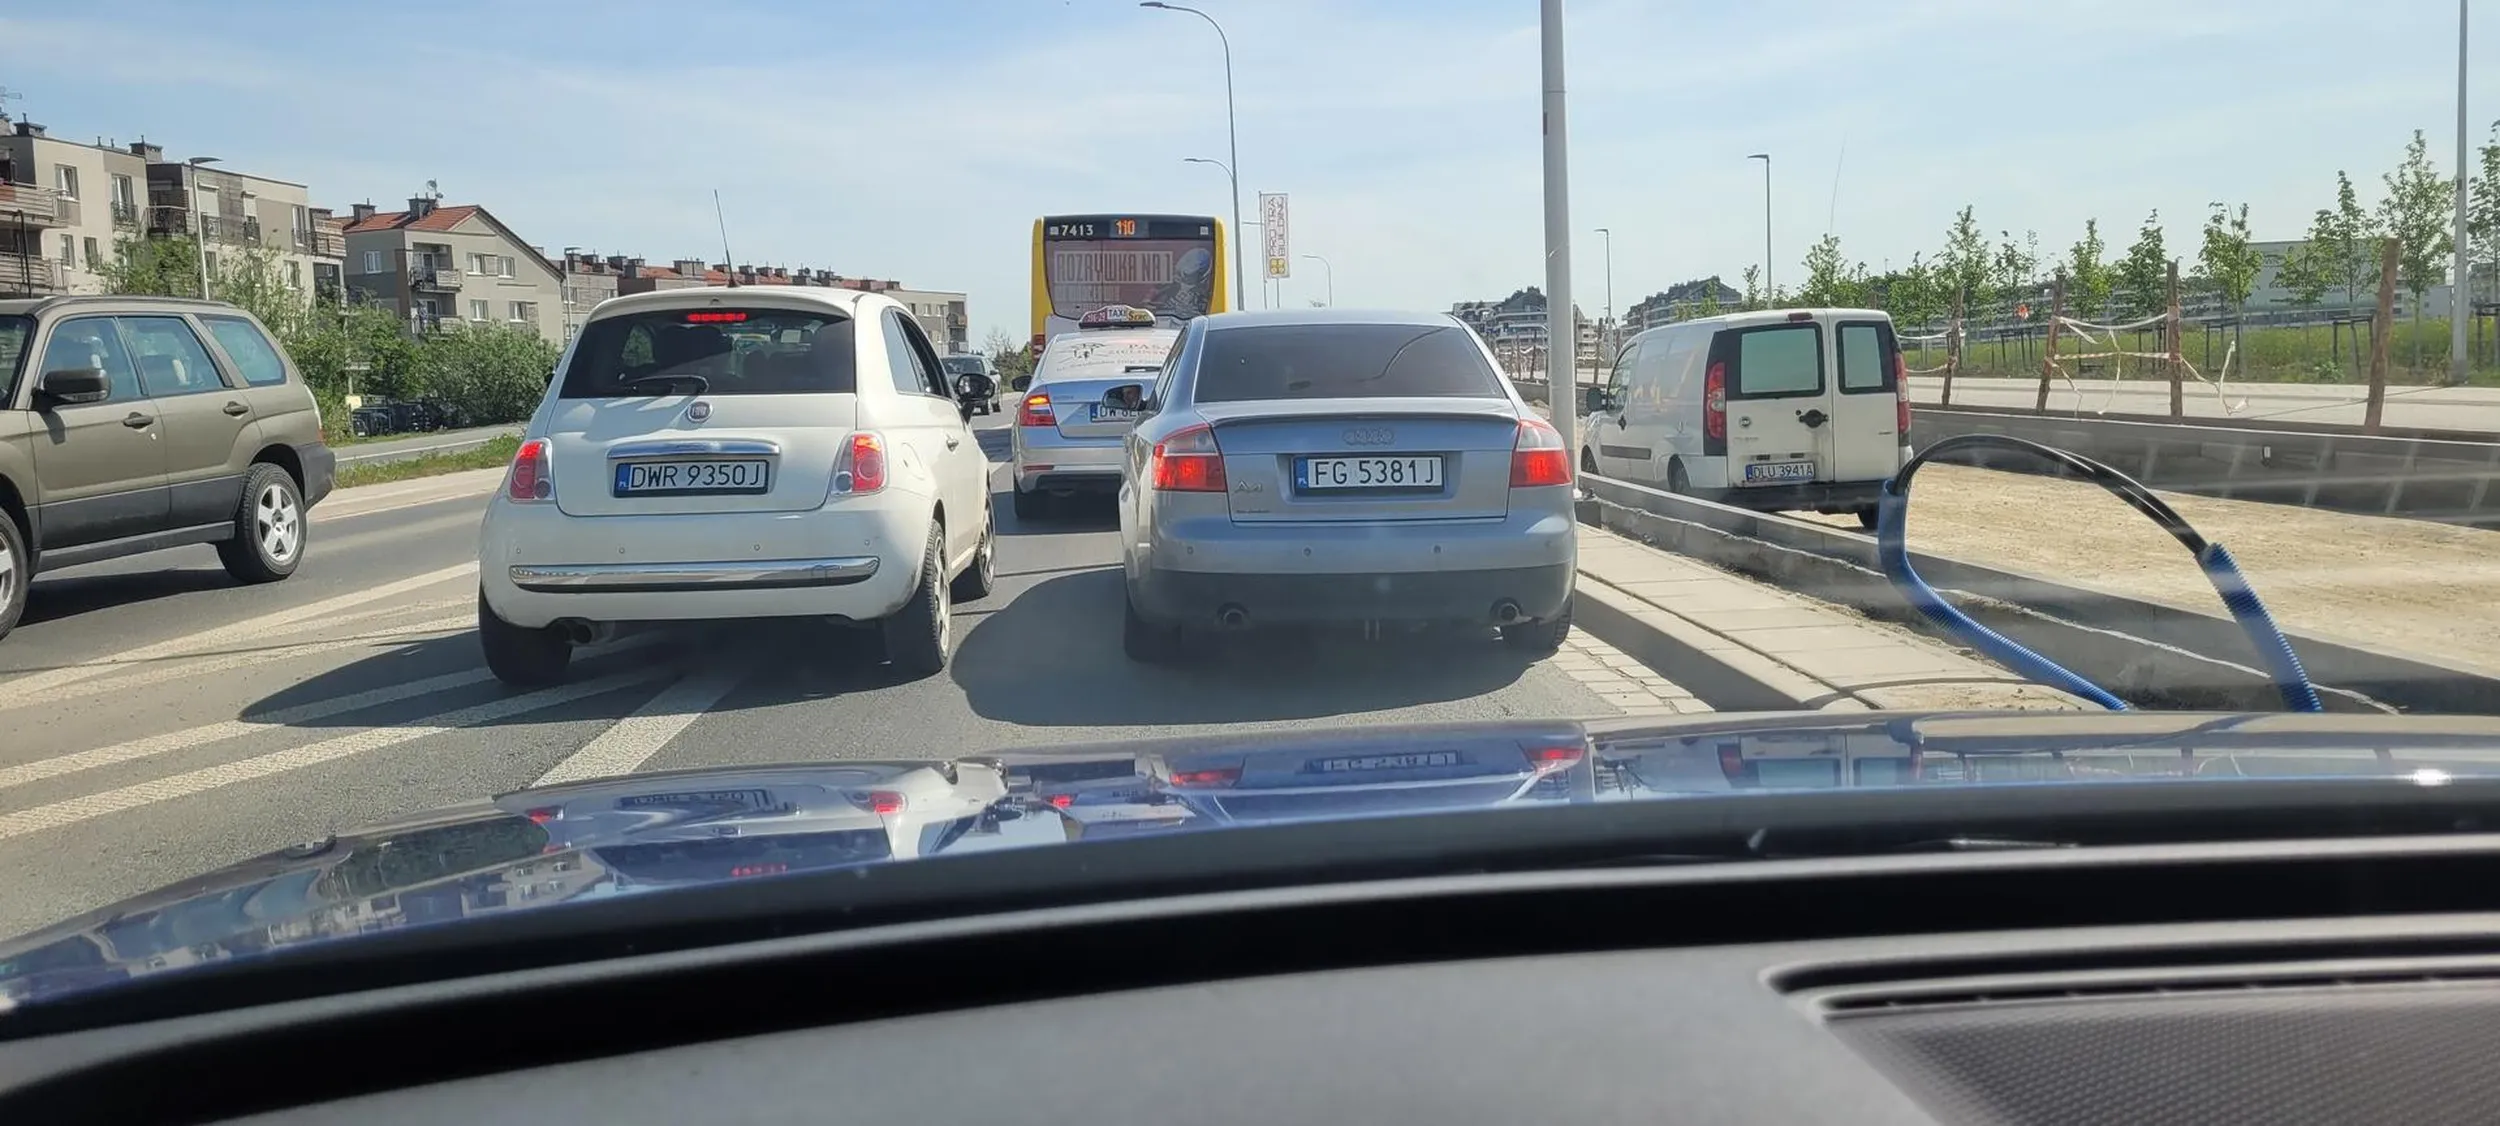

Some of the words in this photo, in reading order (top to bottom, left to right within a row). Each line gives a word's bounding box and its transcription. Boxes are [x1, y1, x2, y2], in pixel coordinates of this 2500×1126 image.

[1061, 224, 1094, 236] 7413
[1115, 220, 1136, 236] 110
[1056, 253, 1137, 282] ROZRYWKA
[1109, 309, 1126, 317] TAXI
[1100, 406, 1116, 417] DW
[630, 465, 678, 489] DWR
[687, 463, 761, 487] 9350J
[1314, 461, 1348, 486] FG
[1358, 459, 1434, 485] 5381J
[1753, 466, 1776, 479] DLU
[1779, 464, 1813, 477] 3941A
